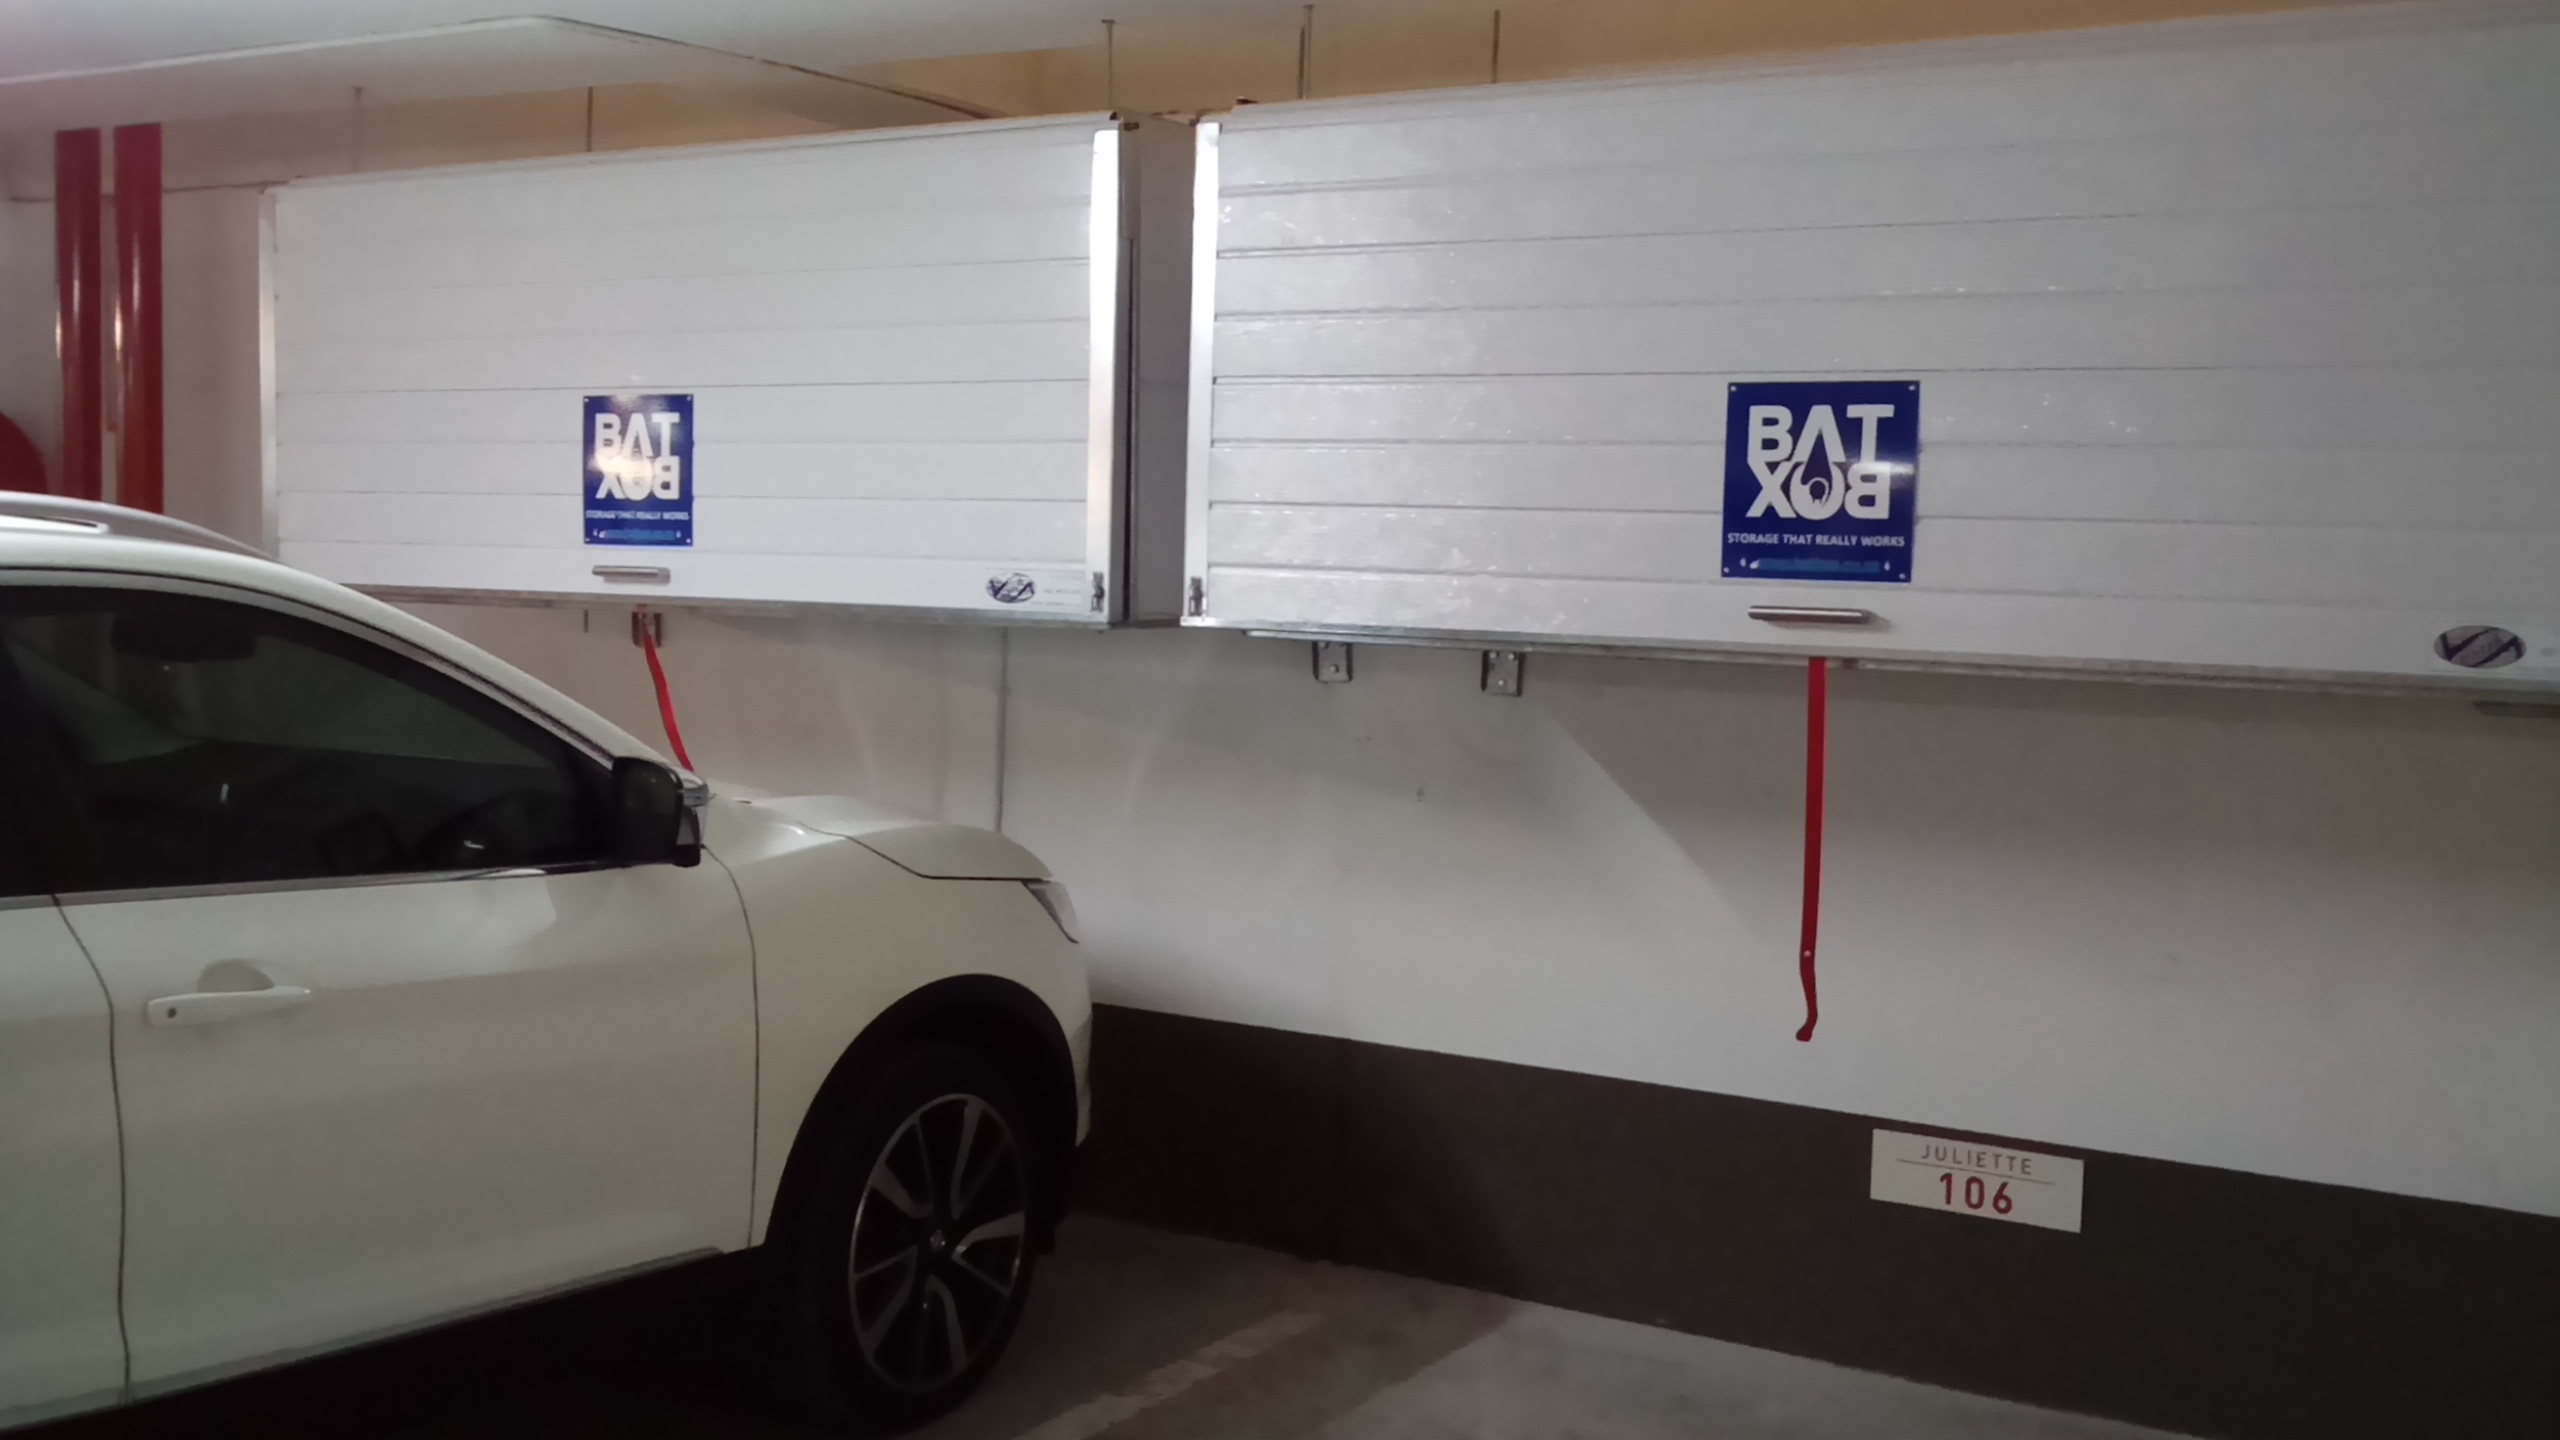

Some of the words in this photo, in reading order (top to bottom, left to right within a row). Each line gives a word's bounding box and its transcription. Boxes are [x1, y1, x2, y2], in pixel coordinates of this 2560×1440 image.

[595, 412, 680, 457] BAT
[1747, 404, 1895, 463] BAT
[1727, 532, 1779, 545] STORAGE
[1783, 534, 1813, 545] THAT
[1815, 534, 1858, 546] REALLY
[1860, 535, 1905, 547] WORKS
[1920, 1143, 2032, 1175] JULIETTE
[1939, 1172, 2013, 1215] 106
